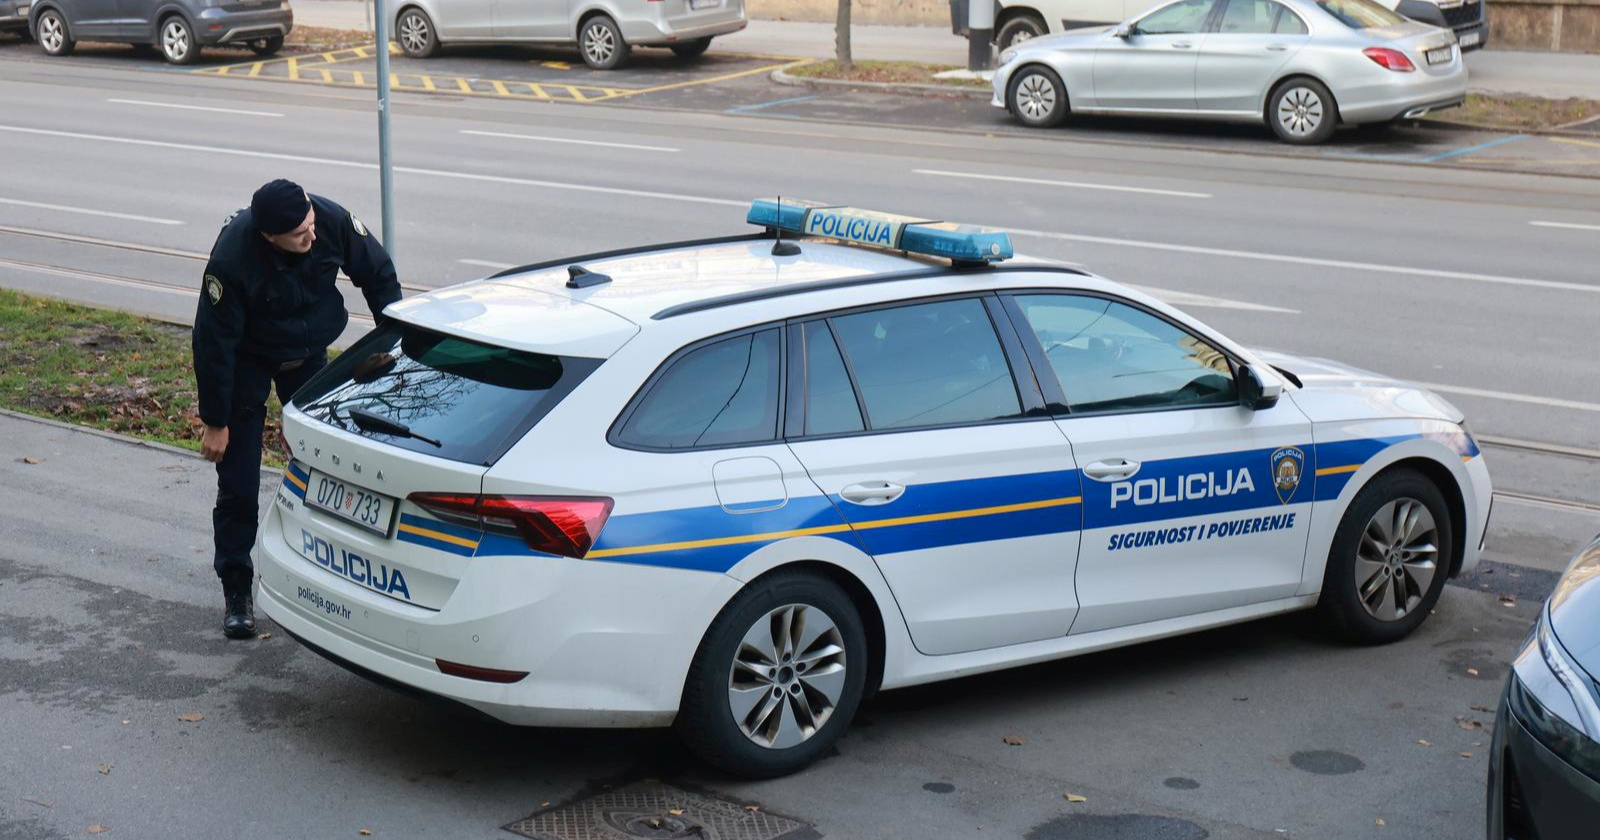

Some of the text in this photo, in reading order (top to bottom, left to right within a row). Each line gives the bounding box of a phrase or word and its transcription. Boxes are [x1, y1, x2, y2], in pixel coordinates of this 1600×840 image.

[810, 213, 891, 245] POLICIJA
[1273, 449, 1302, 462] POLICIJA
[317, 478, 345, 511] 070
[352, 491, 381, 525] 733
[1110, 467, 1255, 509] POLICIJA
[1108, 513, 1296, 551] SIGURNOST I POVJERENJE
[301, 528, 411, 600] POLICIJA
[297, 585, 352, 620] policija.gov.hr
